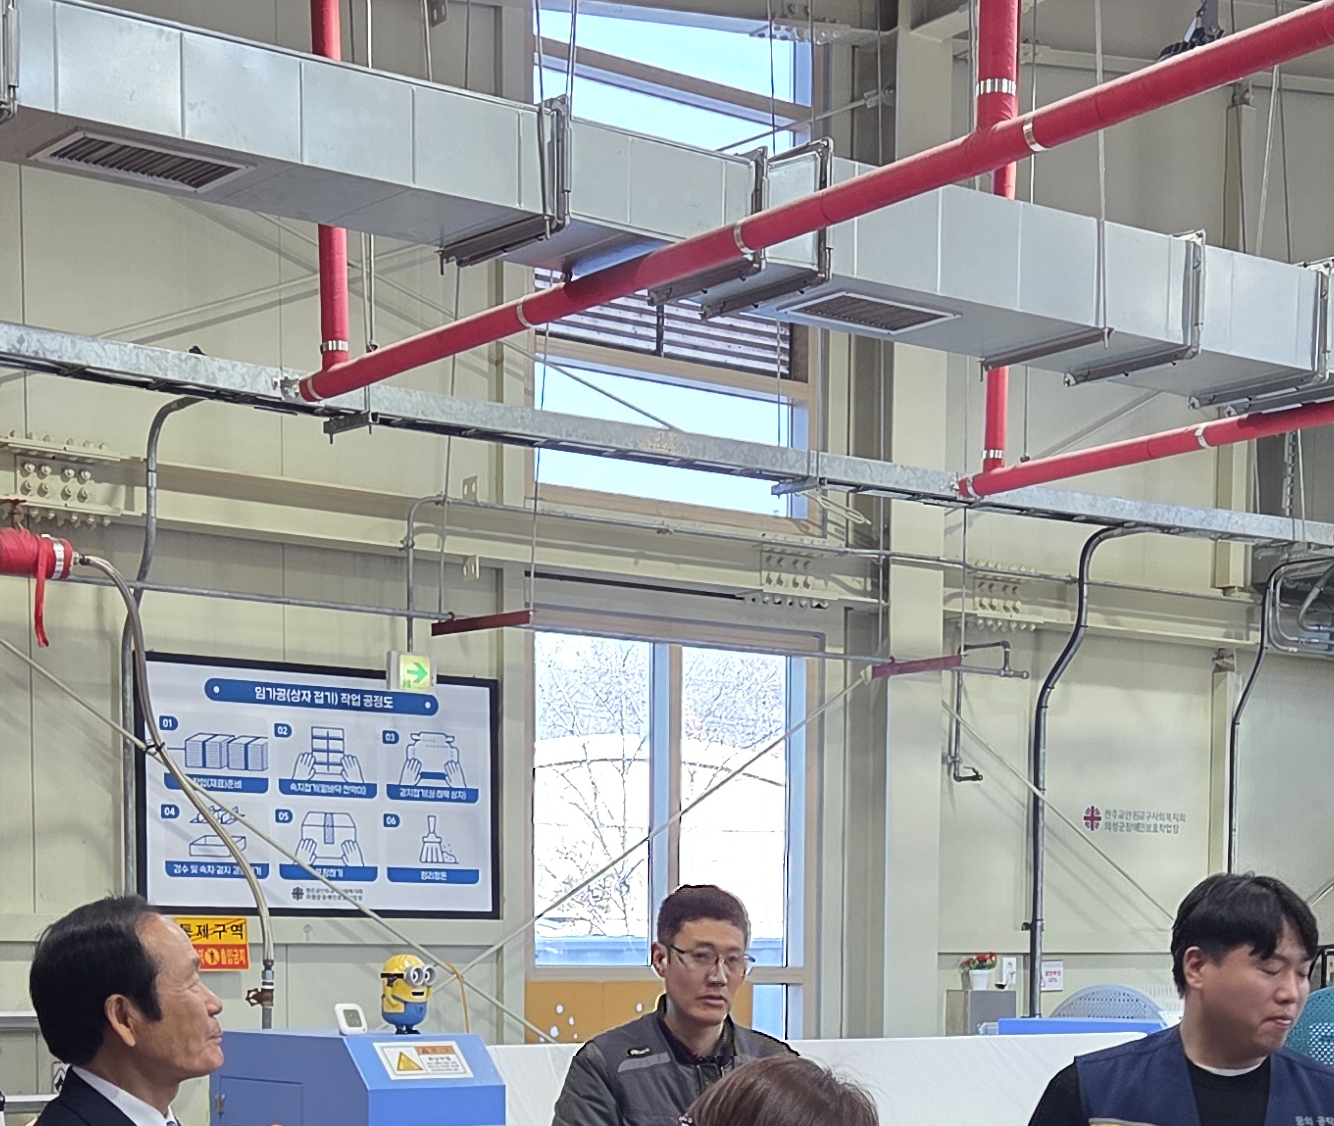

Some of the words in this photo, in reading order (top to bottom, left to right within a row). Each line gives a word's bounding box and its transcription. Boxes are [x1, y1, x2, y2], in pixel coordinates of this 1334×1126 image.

[254, 686, 312, 702] 임가공(상자
[314, 690, 338, 705] 접기)
[340, 695, 361, 707] 작업
[363, 695, 394, 709] 공정도
[162, 718, 173, 728] 01
[277, 726, 288, 735] 02
[385, 733, 395, 742] 03
[164, 807, 175, 816] 04
[278, 811, 289, 821] 05
[386, 816, 396, 825] 06
[173, 863, 189, 874] 검수
[190, 864, 198, 874] 및
[179, 922, 244, 940] 통제구역
